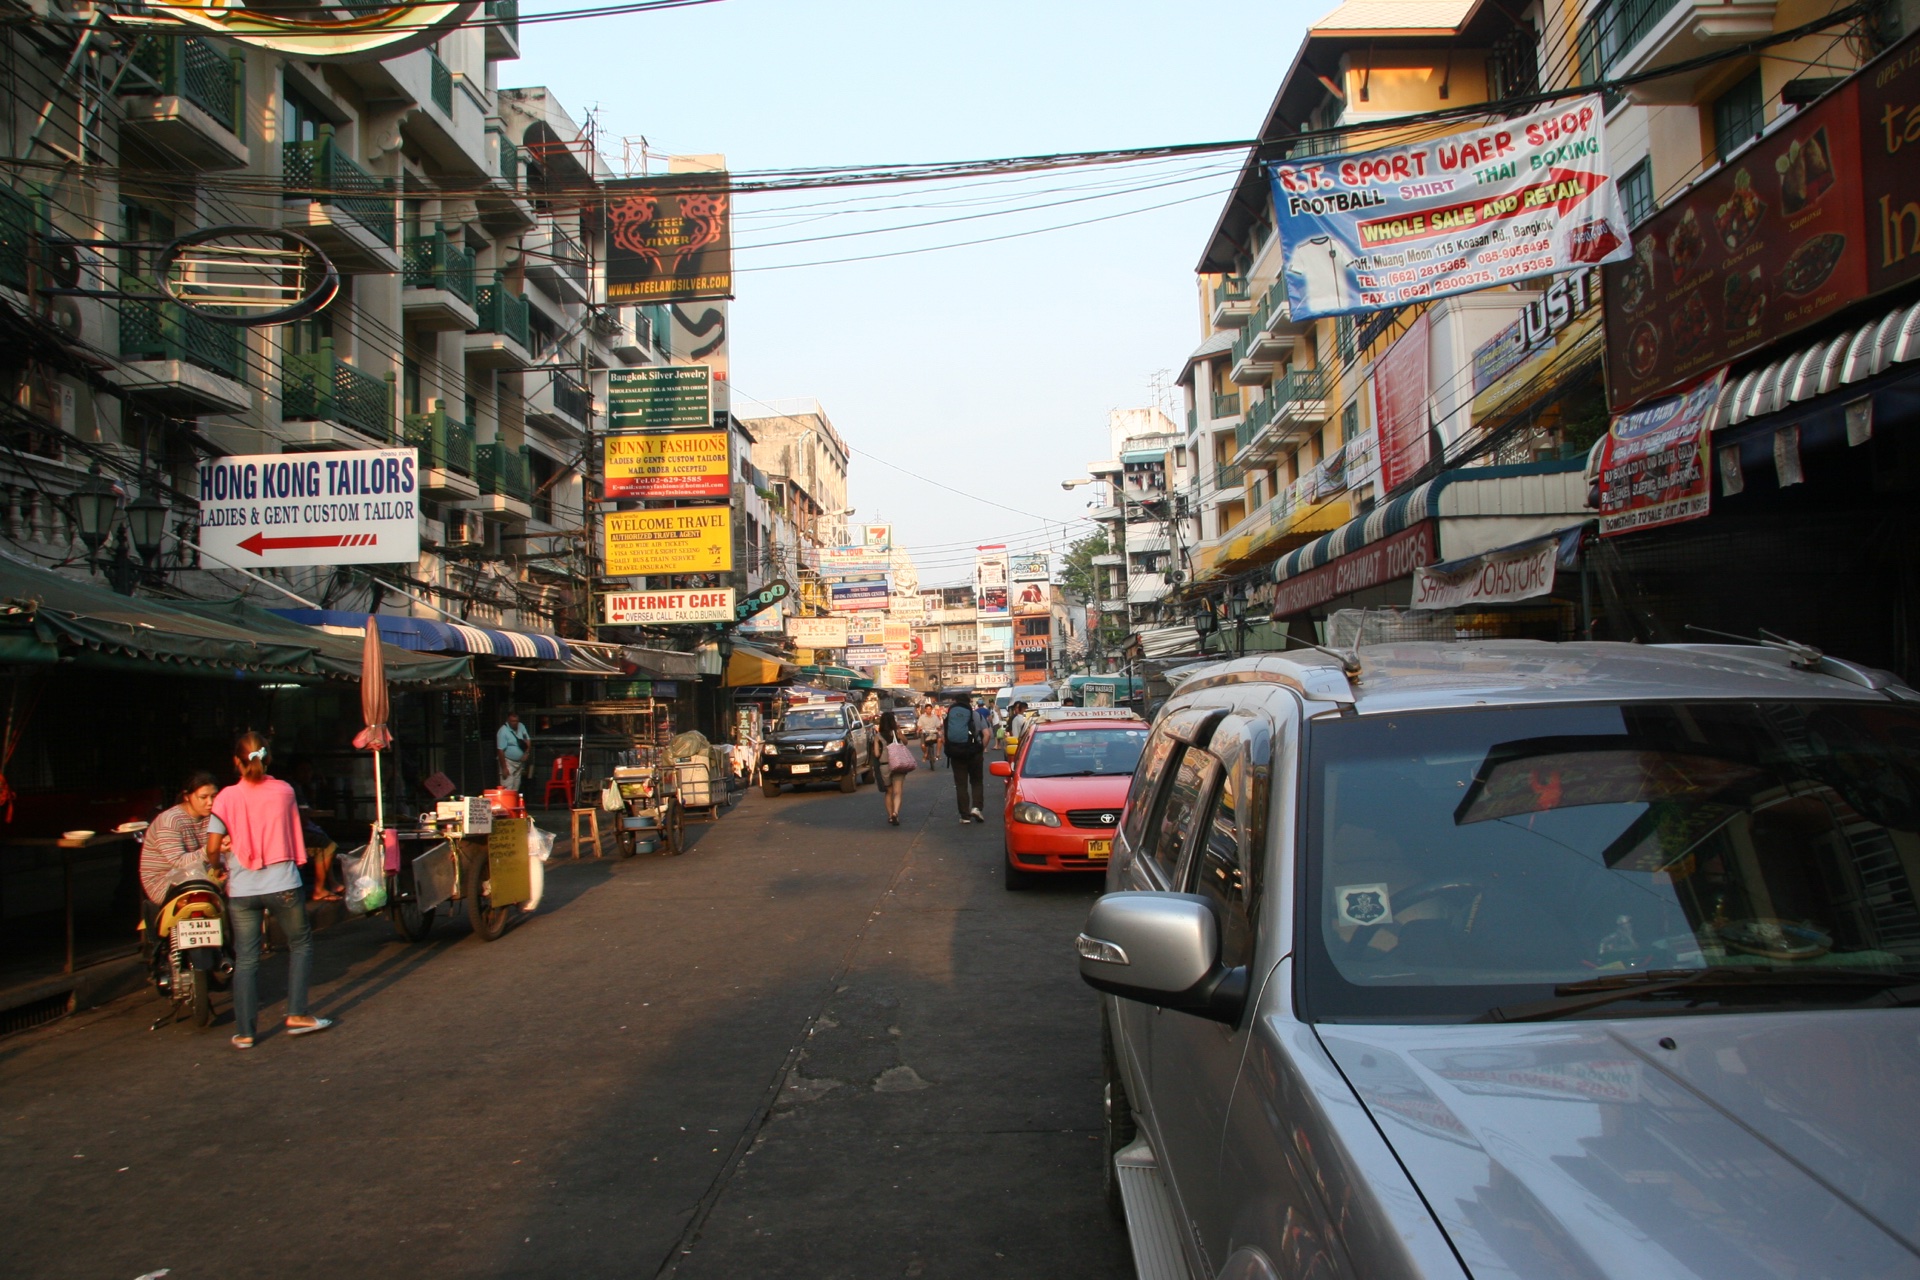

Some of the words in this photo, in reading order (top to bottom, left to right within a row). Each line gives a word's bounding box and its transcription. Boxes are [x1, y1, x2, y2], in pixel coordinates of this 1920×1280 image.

[1876, 59, 1905, 89] OPEN
[1341, 152, 1428, 186] SPORT
[1439, 132, 1515, 169] WAER
[1525, 107, 1593, 146] SHOP
[1290, 191, 1385, 215] FOOTBALL
[1400, 179, 1455, 200] SHIRT
[1472, 161, 1517, 185] THAI
[1530, 137, 1599, 170] BOXING
[1362, 215, 1425, 243] WHOLE
[1431, 211, 1476, 231] SALE
[1482, 195, 1518, 219] AND
[1524, 179, 1586, 208] RETAIL
[650, 217, 686, 228] STEEL
[1788, 207, 1822, 232] Samosa
[645, 236, 690, 247] SILVER
[1374, 254, 1404, 269] Muang
[1407, 249, 1432, 263] Moon
[1436, 242, 1454, 257] 115
[1456, 236, 1490, 250] Koasan
[1513, 219, 1553, 240] Bangkok
[1358, 276, 1377, 287] TEL
[1388, 270, 1416, 286] (662)
[1478, 239, 1550, 264] 085-9056495
[608, 276, 729, 296] WWW.STEELANDSILVER.COM
[1361, 292, 1387, 304] FAX
[1399, 283, 1430, 300] (662)
[1436, 269, 1495, 291] 2800375,
[1499, 257, 1554, 278] 2815365
[1513, 266, 1592, 354] JUST
[610, 373, 647, 383] Bangkok
[649, 372, 673, 381] Silver
[674, 370, 707, 380] Jewelry
[610, 441, 654, 455] SUNNY
[660, 438, 726, 453] FASHIONS
[1677, 446, 1693, 461] GOLD
[697, 454, 726, 462] TAILORS
[673, 465, 707, 473] ACCEPTED
[200, 464, 257, 501] HONG
[263, 461, 320, 498] KONG
[326, 456, 414, 496] TAILORS
[630, 489, 706, 497] www.sunnyfashions.com
[200, 507, 247, 527] LADIES
[250, 506, 260, 525] &
[264, 505, 299, 525] GENT
[304, 503, 359, 523] CUSTOM
[364, 501, 414, 521] TAILOR
[1638, 512, 1647, 523] TO
[1647, 508, 1662, 521] SALE
[611, 518, 673, 531] WELCOME
[677, 515, 725, 528] TRAVEL
[612, 532, 652, 541] AUTHORIZED
[654, 531, 678, 539] TRAVEL
[679, 530, 700, 538] AGENT
[870, 528, 886, 538] 7
[846, 548, 863, 557] TOUR
[1336, 550, 1381, 593] CHAIWAT
[1386, 531, 1428, 575] TOURS
[612, 595, 685, 611] INTERNET
[689, 593, 726, 608] CAFE
[625, 612, 653, 622] OVERSEA
[808, 625, 839, 633] K.B.
[1016, 638, 1047, 646] INDIAN
[189, 936, 211, 945] 911
